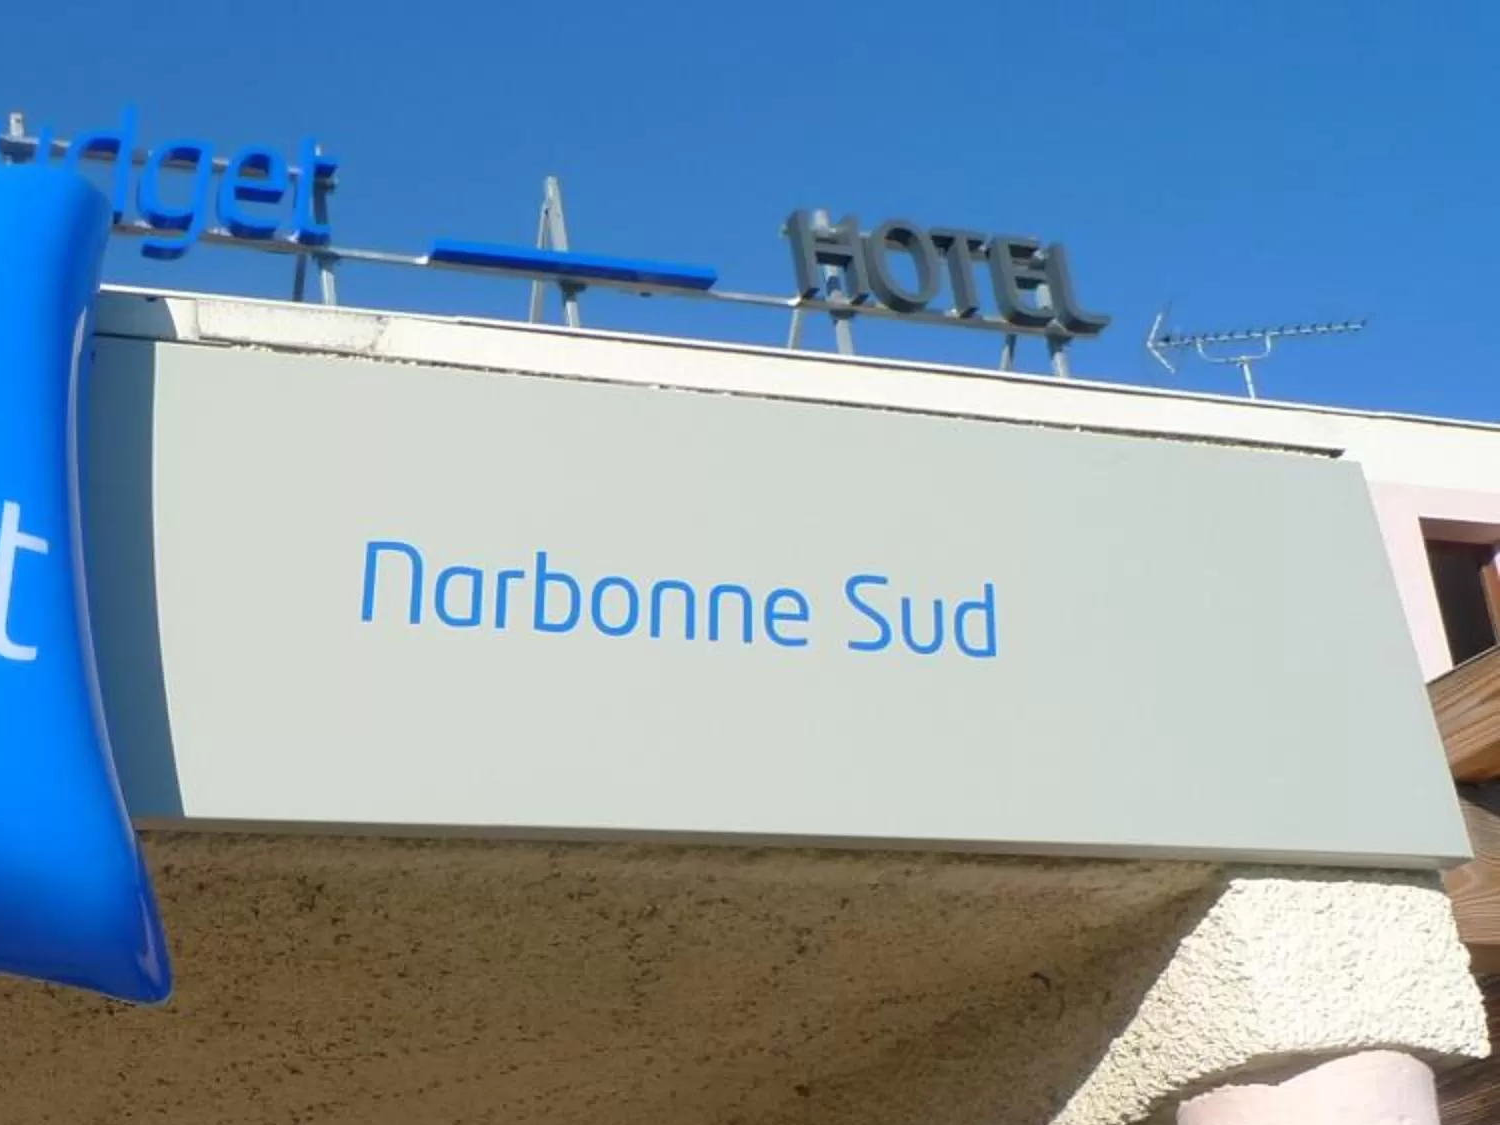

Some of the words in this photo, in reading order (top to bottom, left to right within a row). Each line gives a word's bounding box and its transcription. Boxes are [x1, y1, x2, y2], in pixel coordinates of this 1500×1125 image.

[786, 208, 1111, 335] HOTEL
[361, 540, 809, 648] Narbonne
[845, 574, 997, 658] Sud
